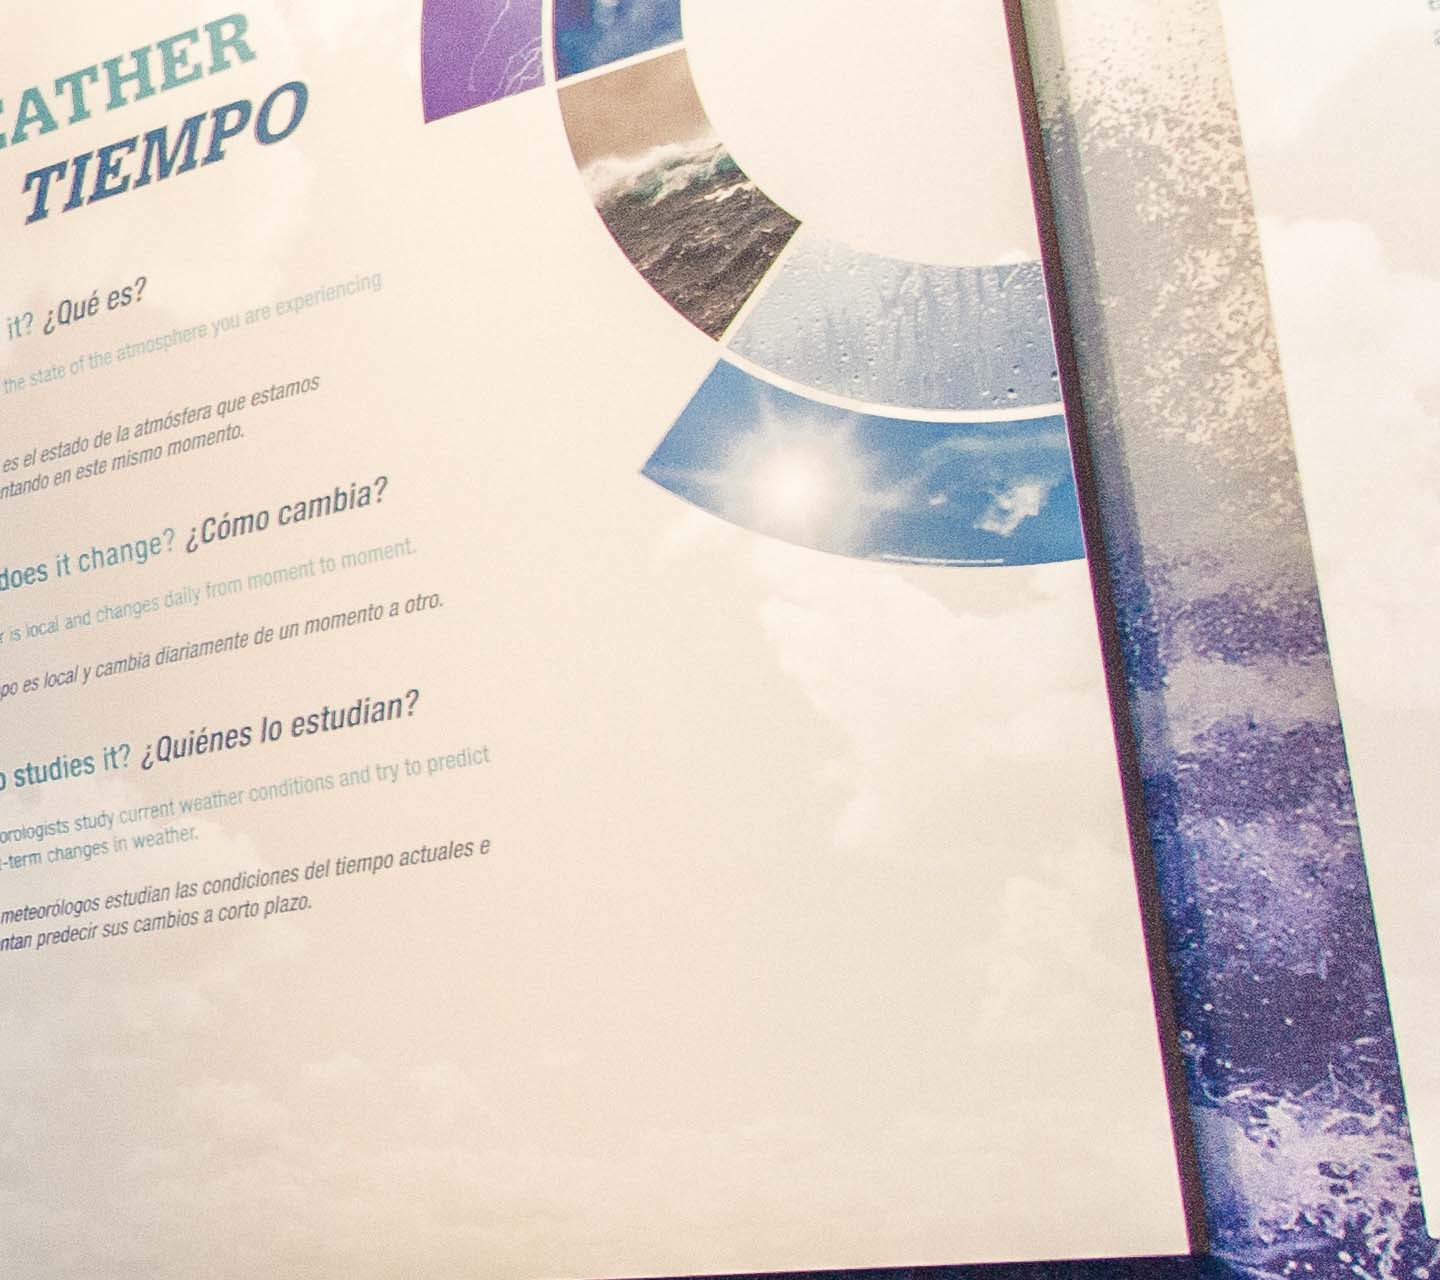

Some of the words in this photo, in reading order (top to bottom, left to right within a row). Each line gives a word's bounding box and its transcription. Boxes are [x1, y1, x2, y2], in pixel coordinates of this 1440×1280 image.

[22, 80, 309, 225] TIEMPO
[7, 311, 34, 340] it?
[42, 290, 100, 336] ¿Qué
[107, 275, 148, 311] es?
[2, 456, 20, 473] es
[22, 448, 37, 468] el
[40, 436, 89, 463] estado
[93, 430, 113, 449] de
[116, 425, 130, 443] la
[133, 405, 212, 439] atmósfera
[216, 395, 247, 418] que
[250, 375, 321, 407] estamos
[53, 469, 72, 487] en
[75, 459, 107, 480] este
[111, 445, 163, 471] mismo
[167, 423, 245, 457] momento.
[56, 554, 71, 578] it
[78, 527, 175, 573] change?
[185, 510, 270, 554] ¿Cómo
[278, 475, 389, 526] cambia?
[26, 616, 60, 638] local
[65, 610, 91, 630] and
[96, 597, 160, 623] changes
[164, 587, 200, 608] daily
[205, 578, 243, 598] from
[247, 559, 316, 590] moment
[318, 557, 337, 574] to
[341, 537, 417, 569] moment.
[22, 677, 40, 693] es
[43, 665, 79, 688] local
[82, 667, 92, 685] y
[95, 652, 151, 678] cambia
[154, 632, 249, 666] diariamente
[253, 626, 274, 646] de
[278, 622, 300, 641] un
[304, 603, 384, 635] momento
[388, 601, 400, 618] a
[404, 593, 444, 614] otro.
[13, 755, 95, 788] studies
[103, 743, 131, 771] it?
[140, 726, 252, 771] ¿Quiénes
[260, 716, 283, 743] lo
[291, 688, 420, 738] estudian?
[74, 810, 114, 831] study
[119, 799, 175, 824] current
[178, 790, 244, 814] weather
[248, 774, 335, 803] conditions
[338, 765, 371, 788] and
[375, 763, 399, 784] try
[403, 758, 422, 777] to
[426, 745, 491, 777] predict
[0, 897, 100, 924] meteorólogos
[104, 885, 171, 910] estudian
[174, 881, 198, 899] las
[202, 867, 300, 896] condiciones
[304, 859, 331, 881] del
[335, 853, 395, 876] tiempo
[398, 840, 475, 867] actuales
[479, 838, 491, 856] e
[47, 841, 109, 863] changes
[132, 826, 199, 849] weather.
[36, 925, 99, 950] predecir
[102, 920, 129, 938] sus
[133, 909, 199, 934] cambios
[203, 908, 214, 924] a
[217, 900, 260, 922] corto
[263, 895, 312, 919] plazo.
